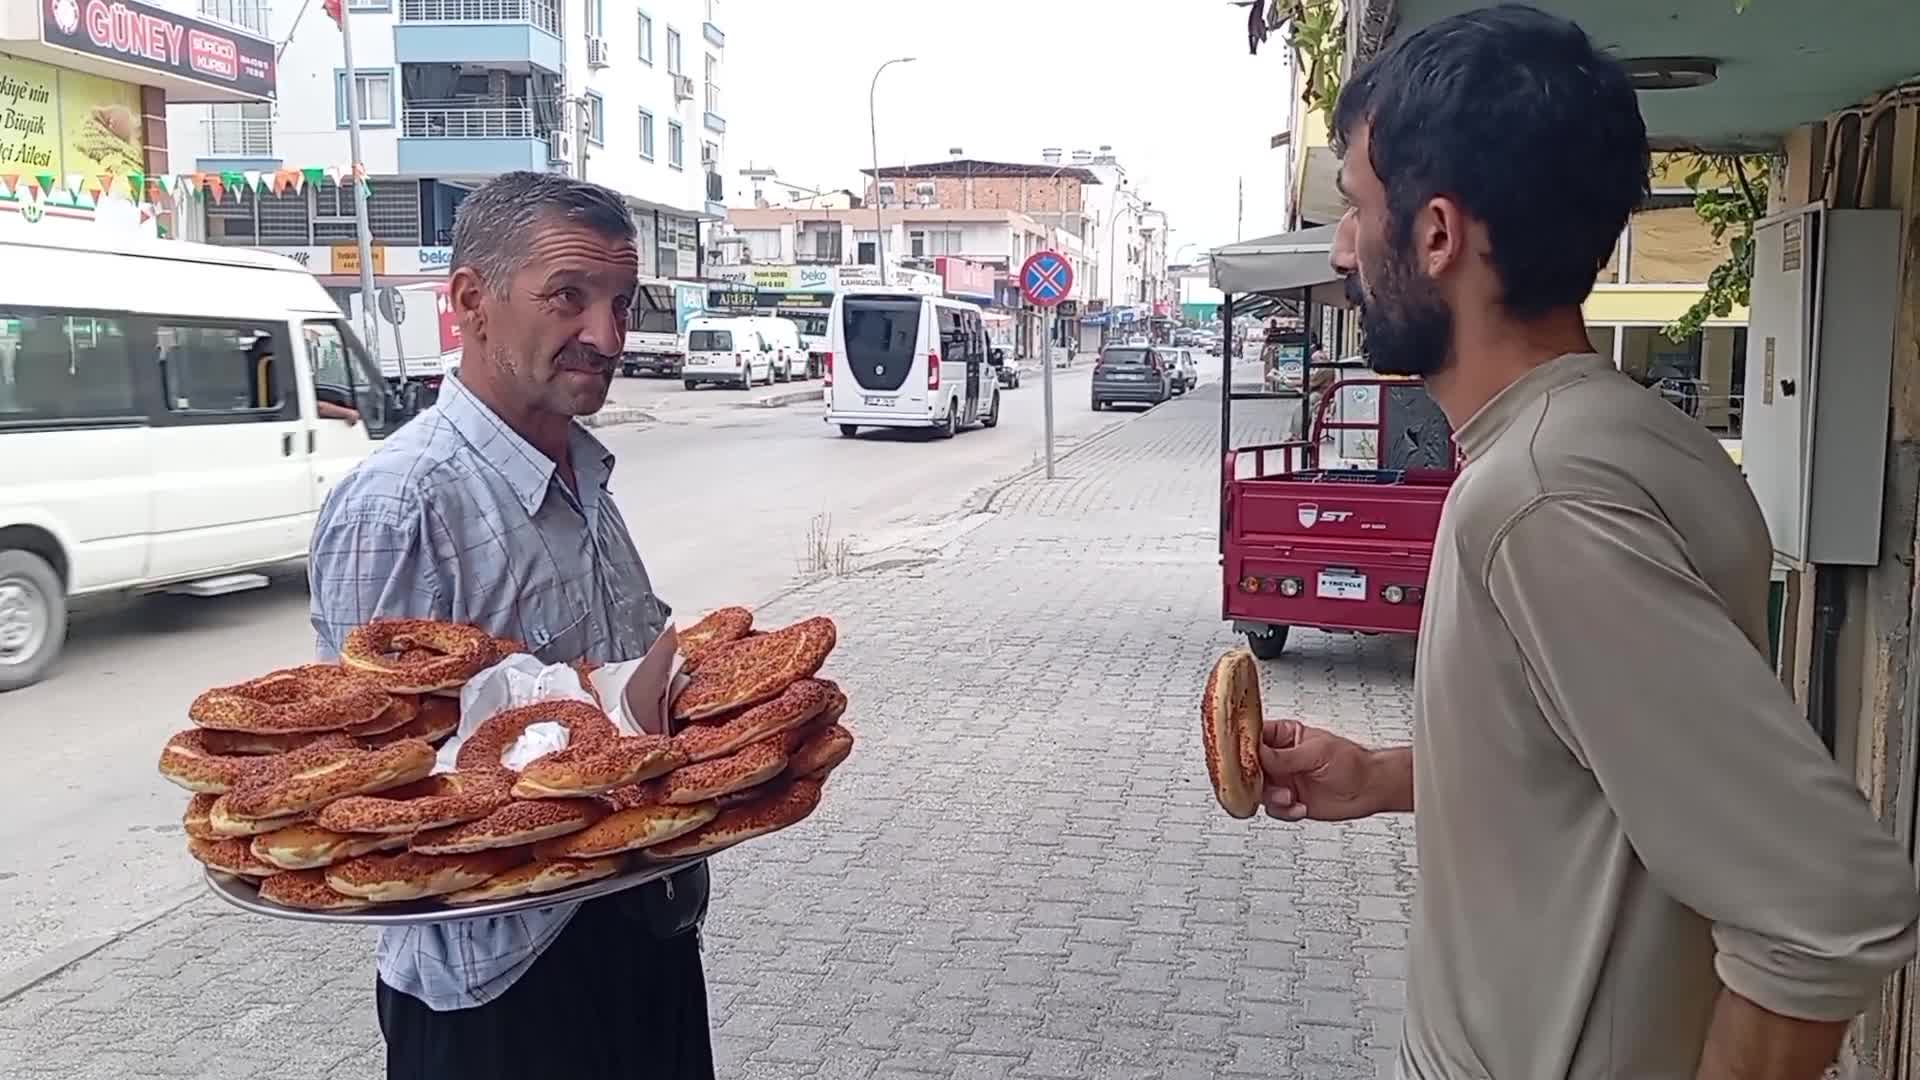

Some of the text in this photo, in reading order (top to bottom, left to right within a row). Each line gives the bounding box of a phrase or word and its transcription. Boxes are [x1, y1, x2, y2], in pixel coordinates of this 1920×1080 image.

[86, 0, 184, 66] GÜNEY
[192, 37, 234, 60] SÜRÜCÜ
[196, 55, 232, 75] KURSU
[4, 107, 46, 139] Büyük
[14, 142, 52, 167] Ailesi
[800, 269, 827, 281] beko
[1319, 511, 1354, 522] ST
